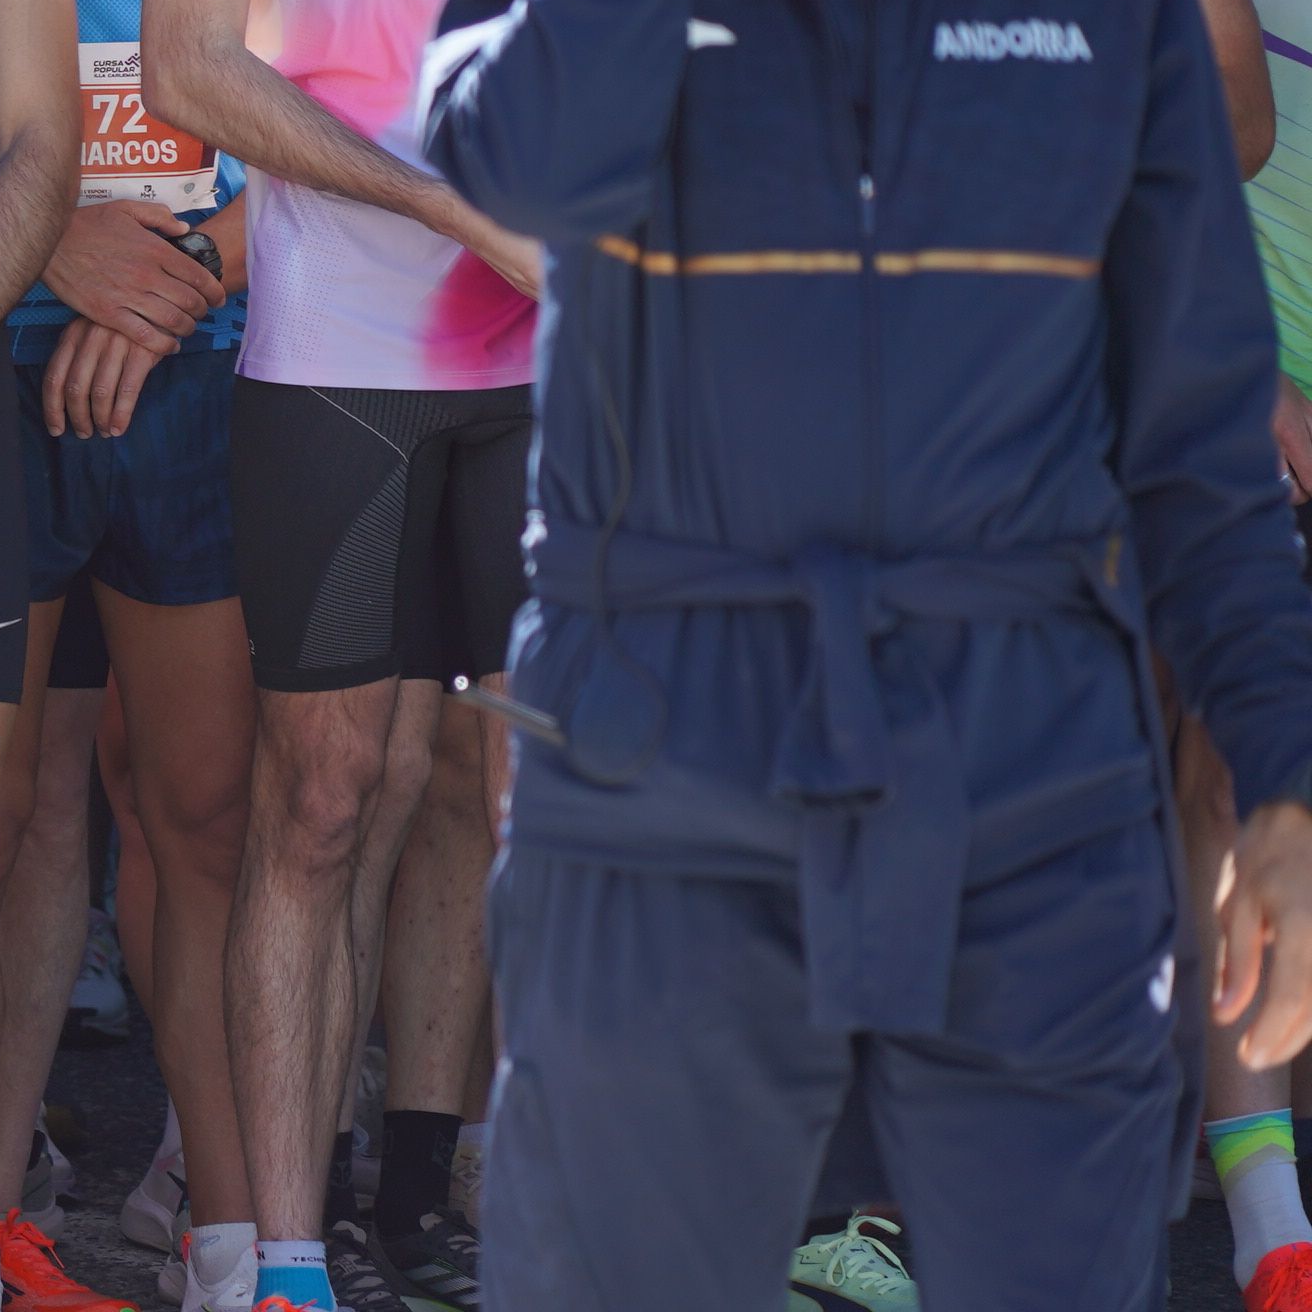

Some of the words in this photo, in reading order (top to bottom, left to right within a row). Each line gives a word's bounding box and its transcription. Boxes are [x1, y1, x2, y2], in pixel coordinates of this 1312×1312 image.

[933, 18, 1094, 63] ANDORRA
[92, 93, 148, 134] 72
[81, 139, 179, 166] ARCOS
